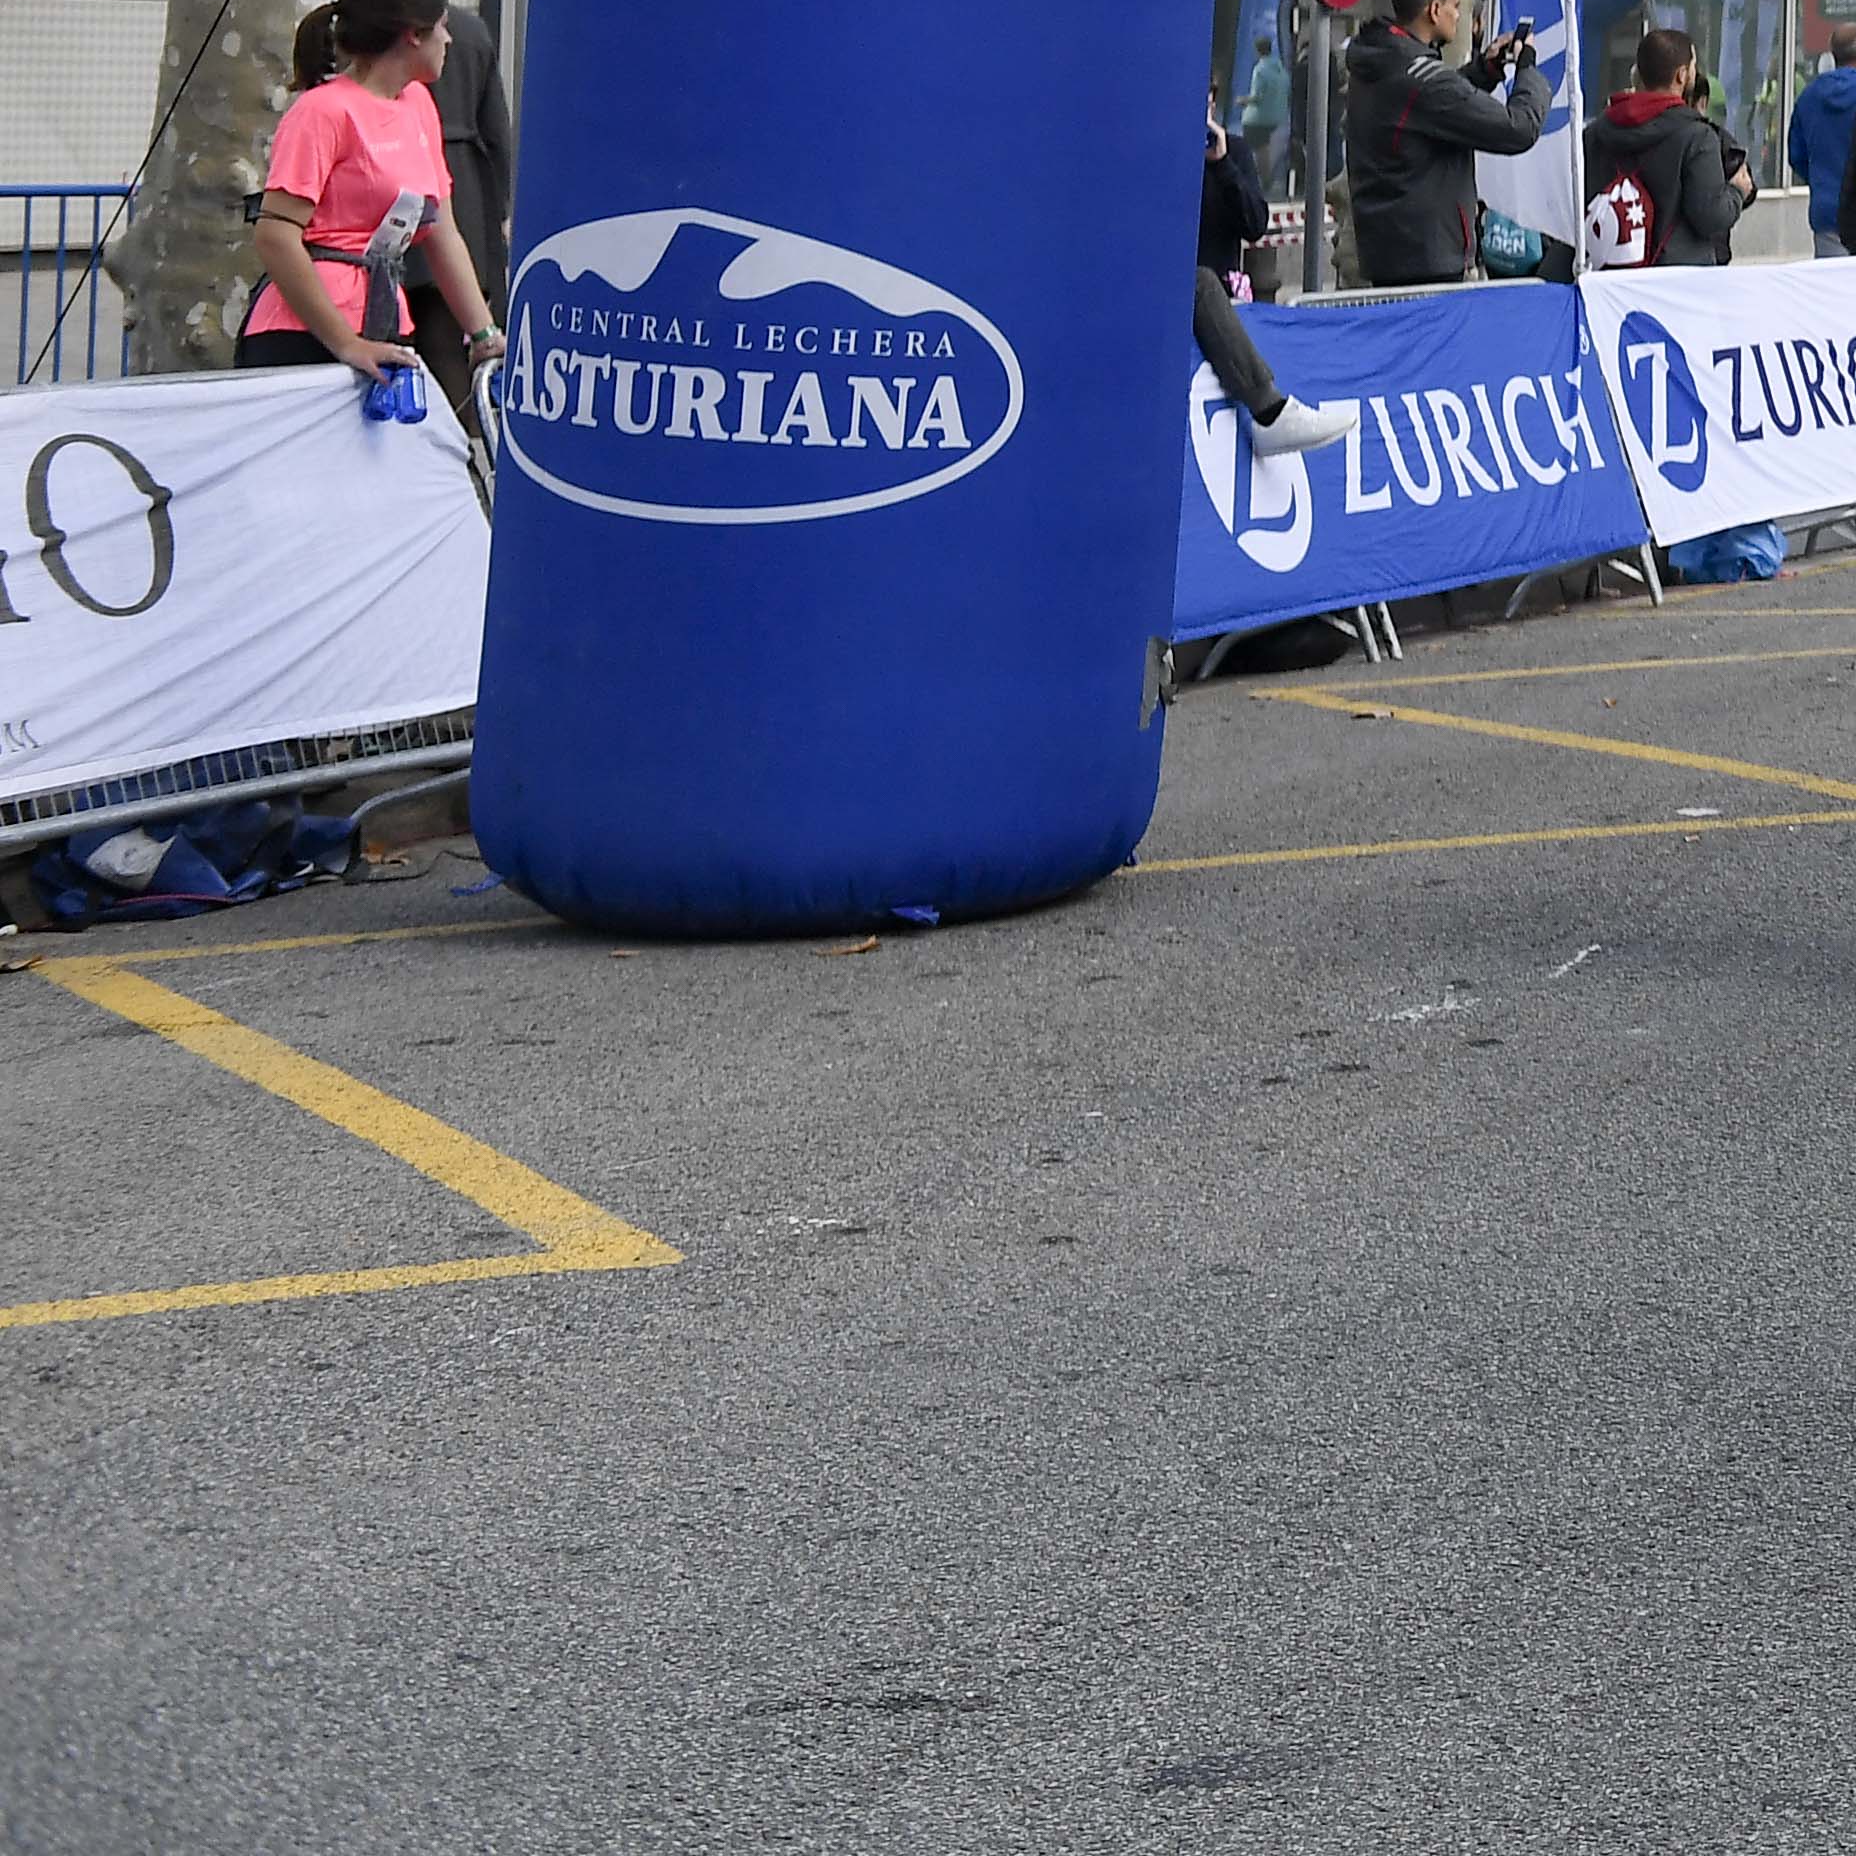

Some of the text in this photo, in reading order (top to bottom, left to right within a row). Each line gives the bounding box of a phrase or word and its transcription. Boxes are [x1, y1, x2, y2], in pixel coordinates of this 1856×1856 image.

[506, 301, 973, 450] ASTURIANA
[550, 302, 957, 358] CENTRAL LECHERA
[1322, 366, 1605, 514] ZURICH
